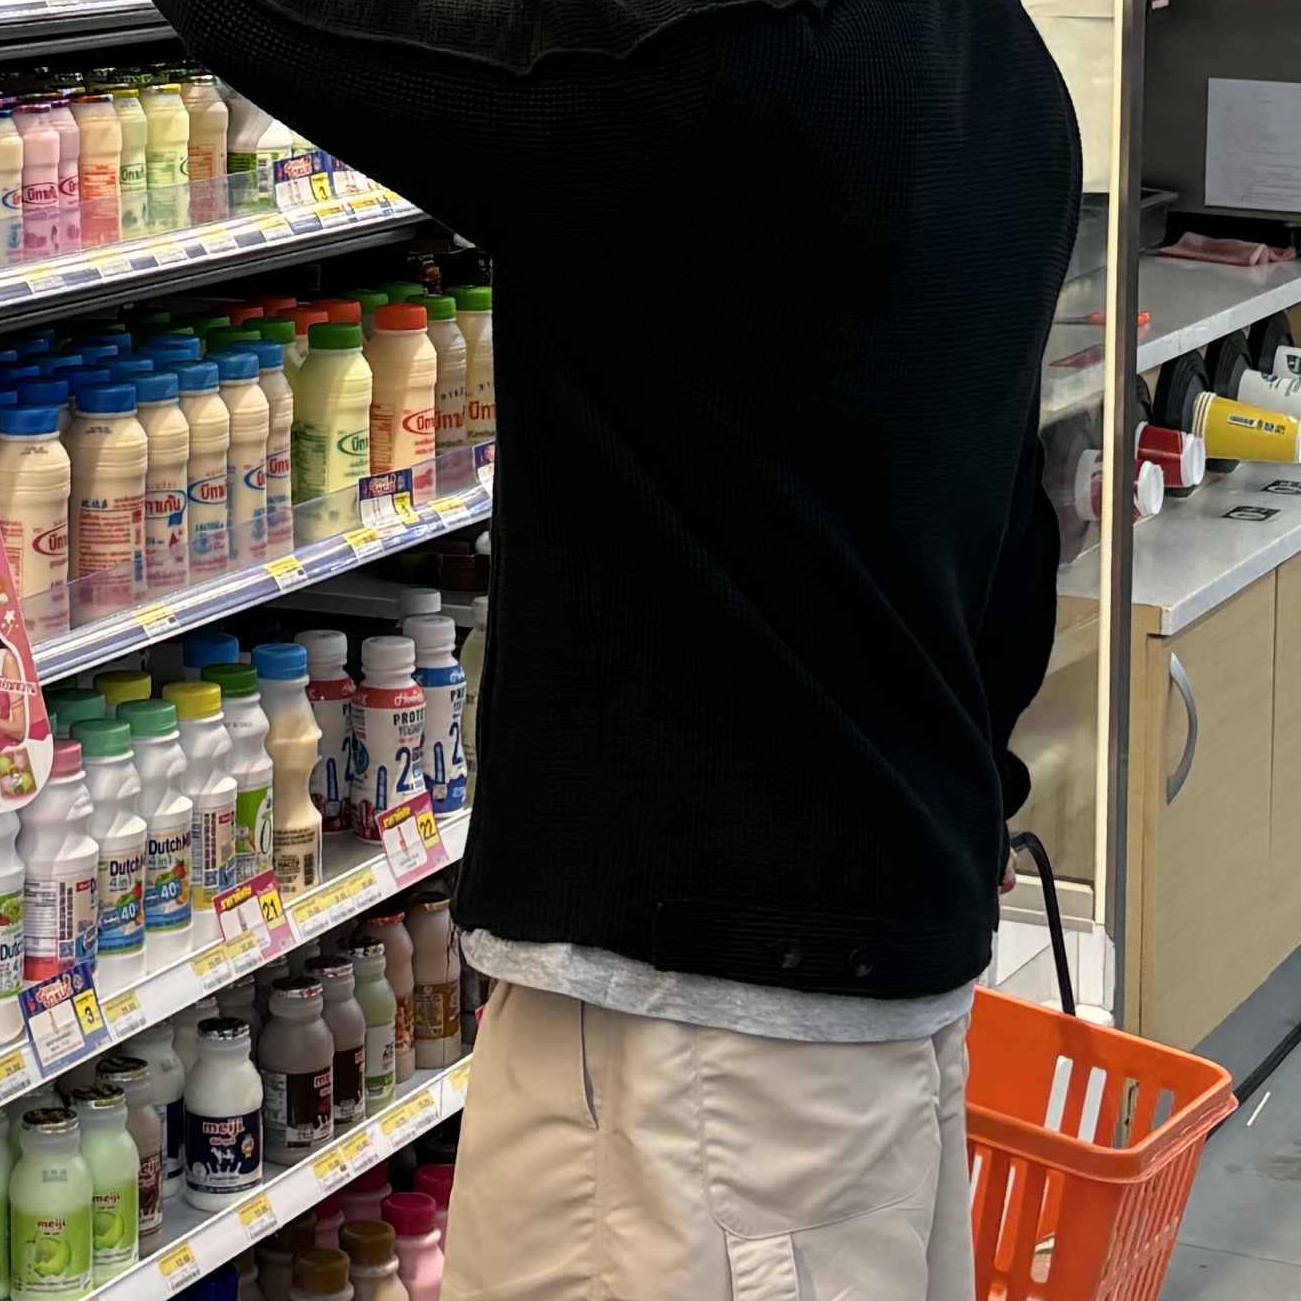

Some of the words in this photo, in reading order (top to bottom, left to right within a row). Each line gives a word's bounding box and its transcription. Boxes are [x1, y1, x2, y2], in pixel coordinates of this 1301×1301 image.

[149, 838, 181, 857] Dutch
[110, 856, 140, 878] Dutch
[203, 1117, 244, 1136] meiji
[37, 1217, 66, 1231] meiji
